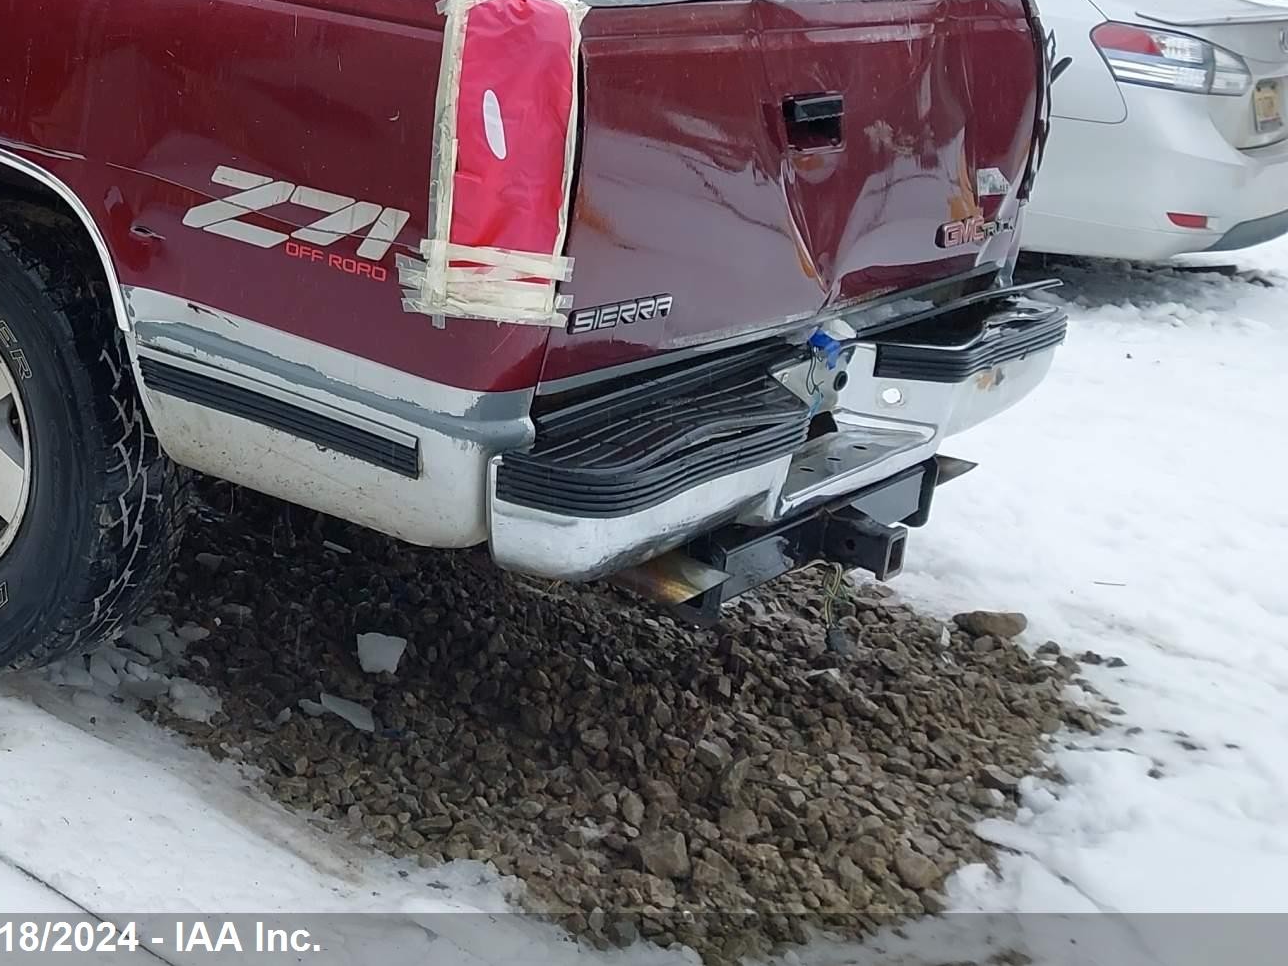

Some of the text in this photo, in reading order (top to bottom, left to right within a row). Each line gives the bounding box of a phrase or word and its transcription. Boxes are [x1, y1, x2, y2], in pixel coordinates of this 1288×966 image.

[182, 165, 411, 261] Z71
[944, 215, 985, 247] GMC
[285, 242, 388, 281] OFF ROAD
[569, 294, 673, 334] SIERRA
